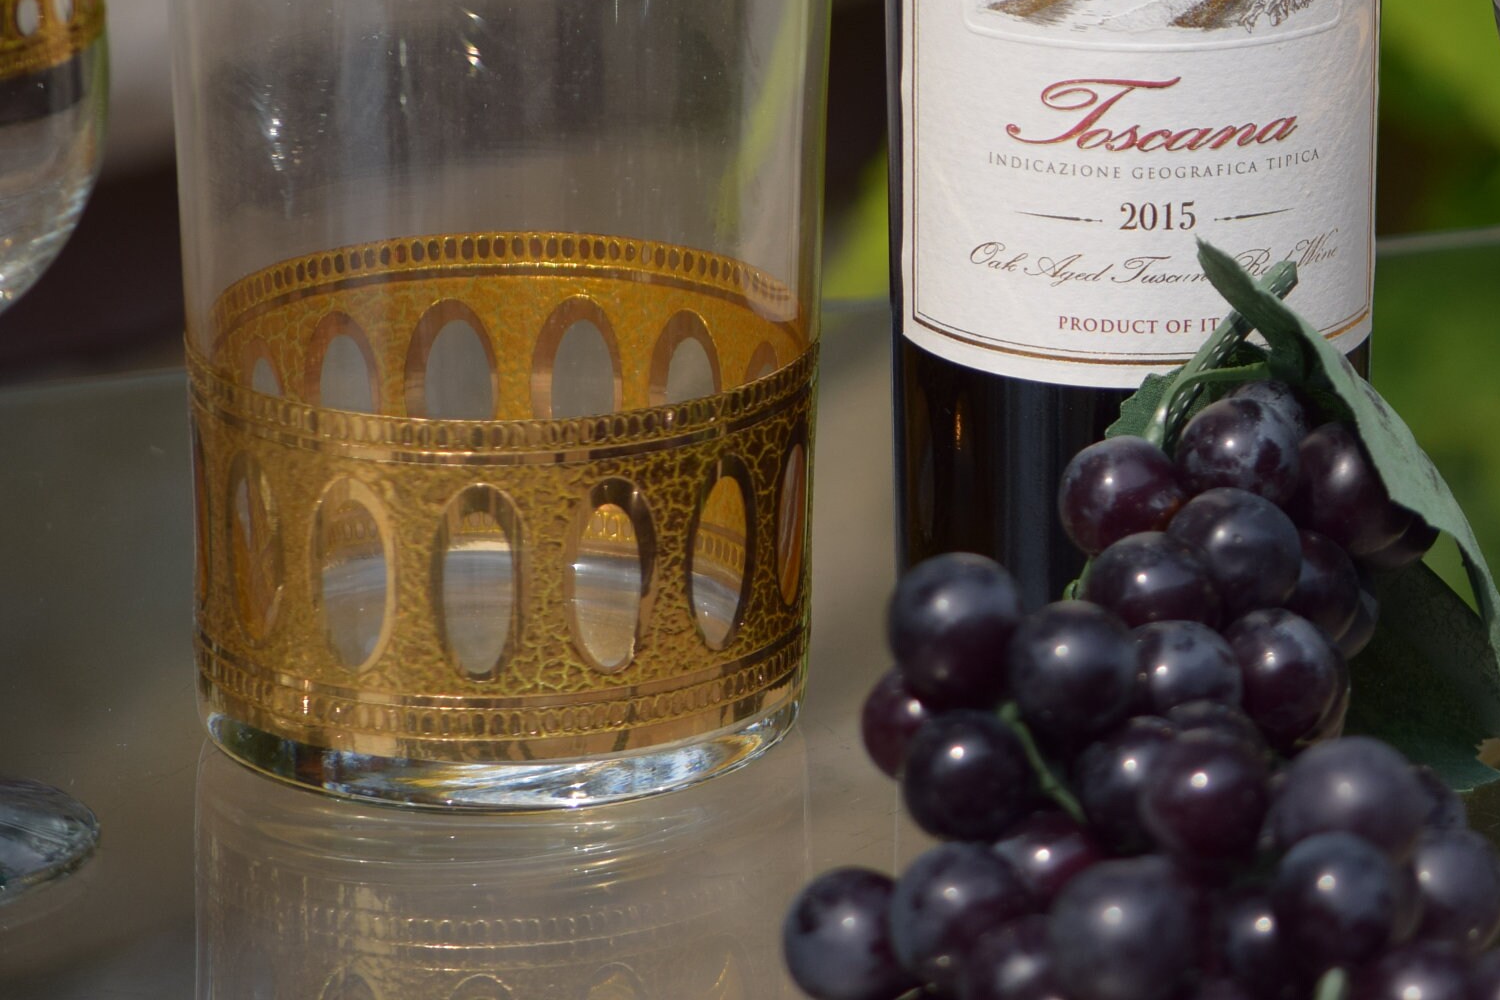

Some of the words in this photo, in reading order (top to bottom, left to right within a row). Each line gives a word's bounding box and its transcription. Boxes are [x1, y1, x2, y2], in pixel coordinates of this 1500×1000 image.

[1006, 76, 1299, 153] Toscana
[988, 151, 1121, 179] INDICAZIONE
[1131, 161, 1257, 180] GEOGRAFICA
[1266, 148, 1320, 171] TIPICA
[1119, 200, 1196, 231] 2015
[970, 241, 1028, 272] Oak
[1024, 253, 1113, 287] Aged
[1295, 228, 1339, 267] Wine
[1059, 315, 1158, 334] PRODUCT
[1166, 319, 1192, 334] OF
